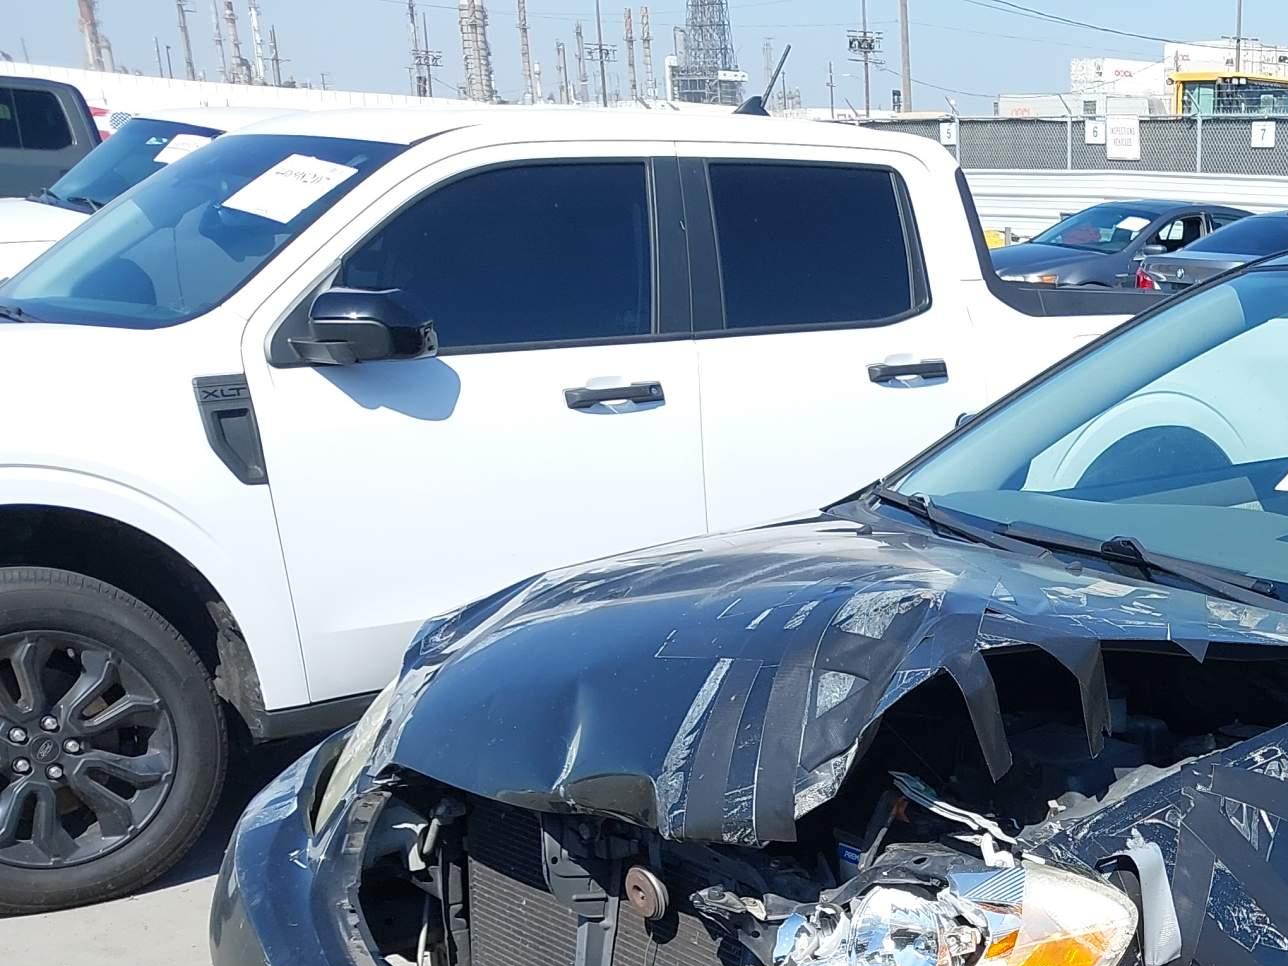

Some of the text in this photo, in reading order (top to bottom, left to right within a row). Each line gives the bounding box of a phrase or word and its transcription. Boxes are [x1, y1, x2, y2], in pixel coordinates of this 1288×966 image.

[946, 128, 952, 140] 5
[1092, 126, 1098, 138] 6
[1260, 128, 1267, 142] 7
[201, 386, 247, 400] XLT
